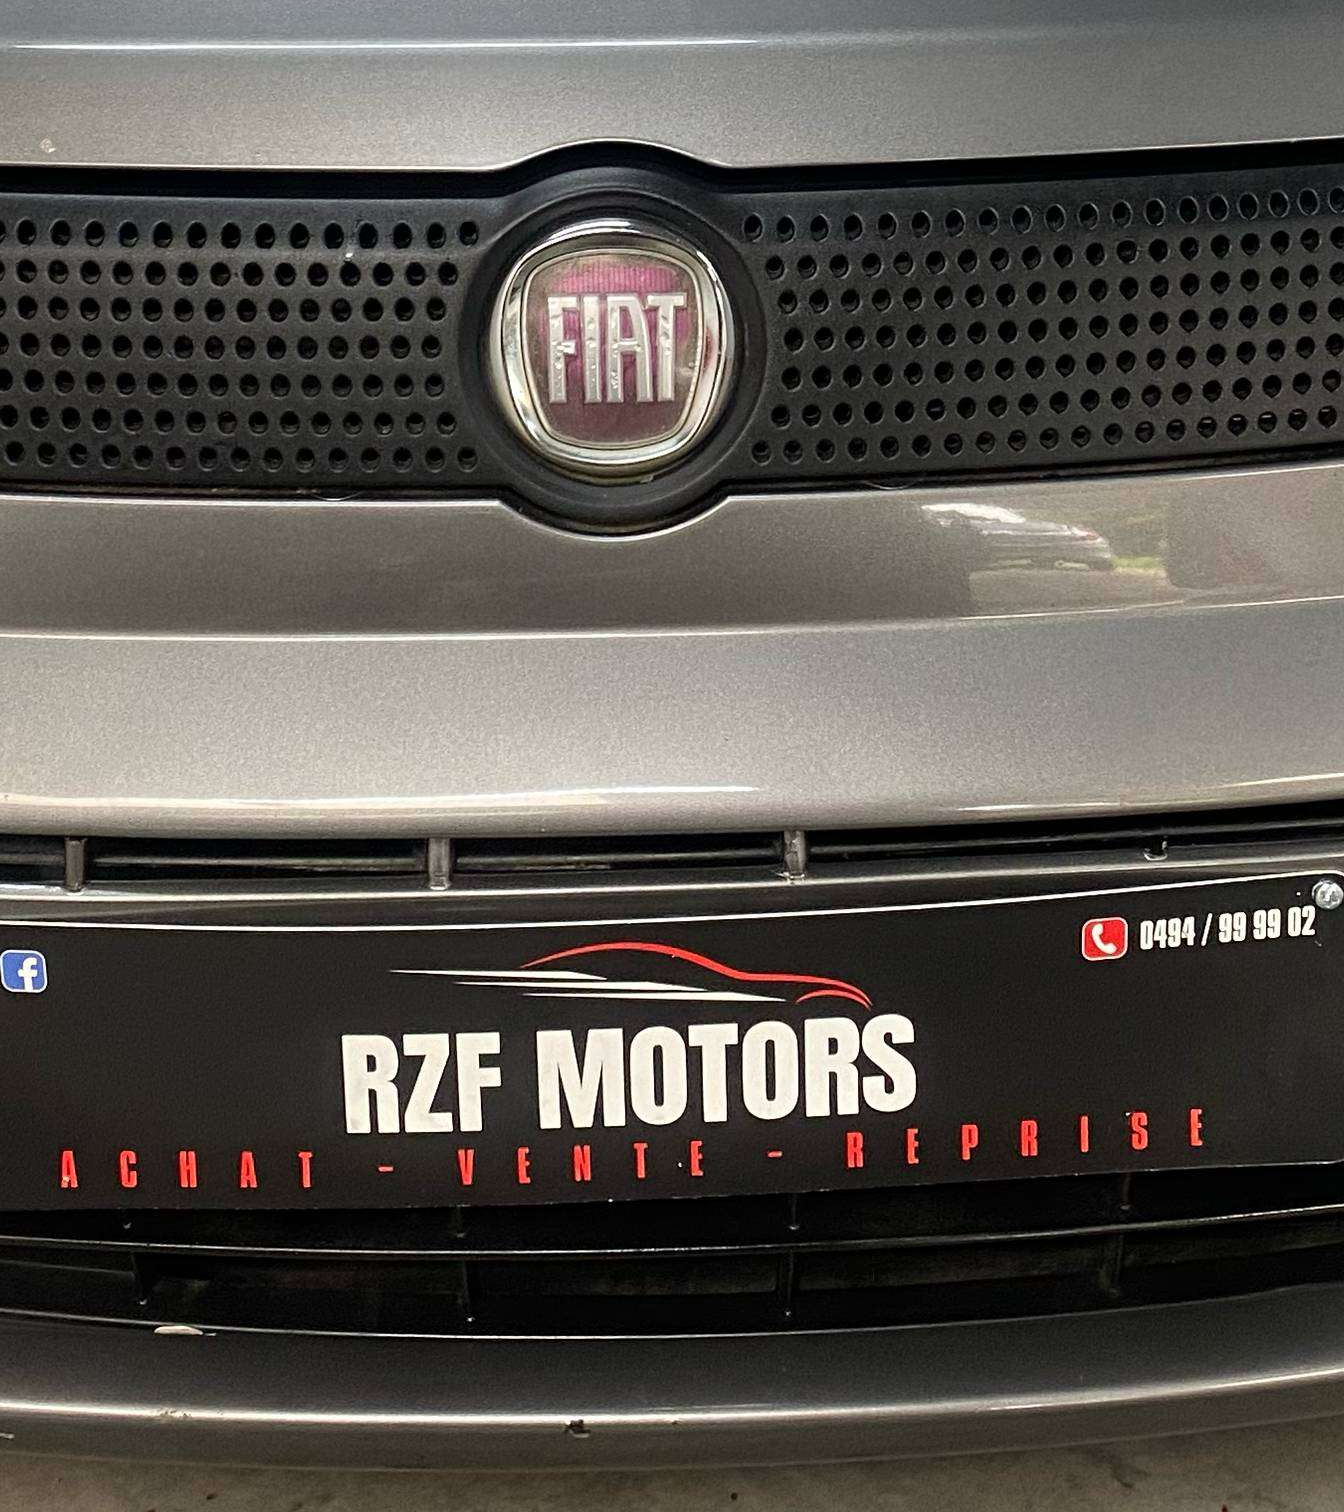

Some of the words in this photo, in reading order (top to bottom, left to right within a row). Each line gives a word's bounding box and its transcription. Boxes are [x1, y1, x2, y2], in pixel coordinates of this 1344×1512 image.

[547, 292, 687, 404] FIAT
[1139, 915, 1196, 950] 0494
[1217, 911, 1248, 943] 99
[1252, 908, 1282, 940] 99
[1286, 904, 1316, 937] 02
[341, 1031, 503, 1135] RZF
[536, 1013, 917, 1131] MOTORS
[60, 1149, 313, 1189] ACHAT
[457, 1140, 704, 1186] VENTE
[845, 1107, 1204, 1170] REPRISE
